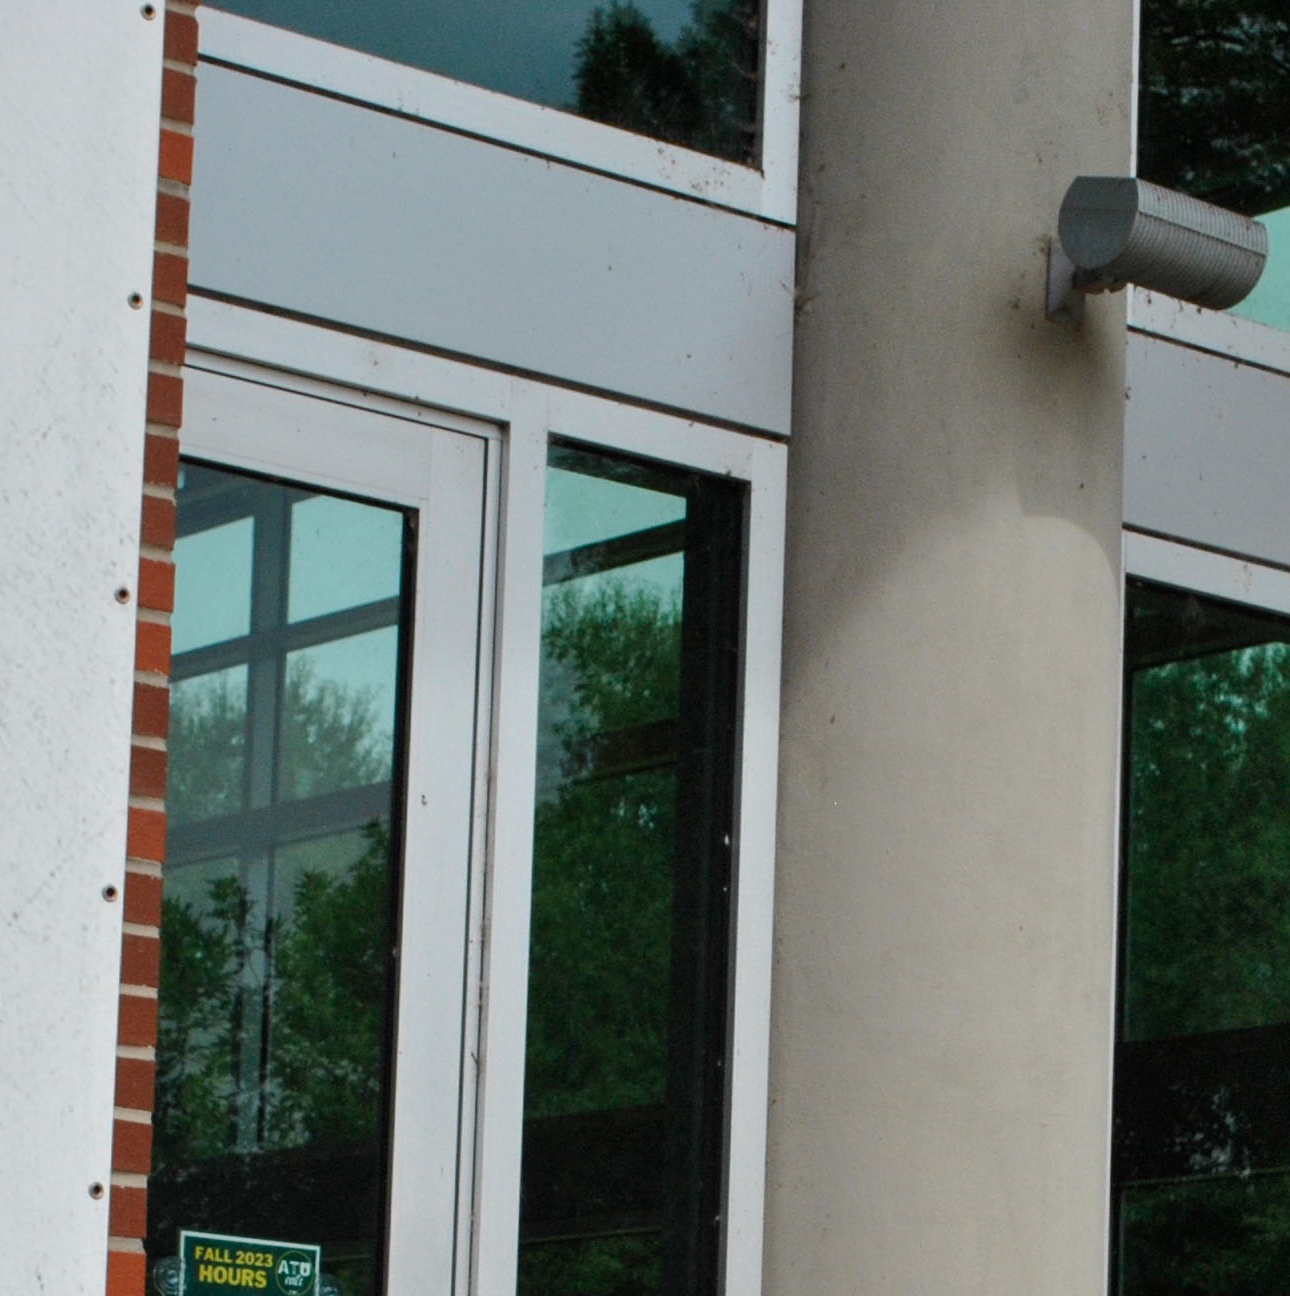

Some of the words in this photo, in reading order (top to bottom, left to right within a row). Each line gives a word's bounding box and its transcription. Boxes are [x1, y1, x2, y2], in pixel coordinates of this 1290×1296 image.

[194, 1246, 232, 1264] FALL
[235, 1250, 274, 1268] 2023
[277, 1259, 311, 1277] ATU
[198, 1265, 267, 1288] HOURS
